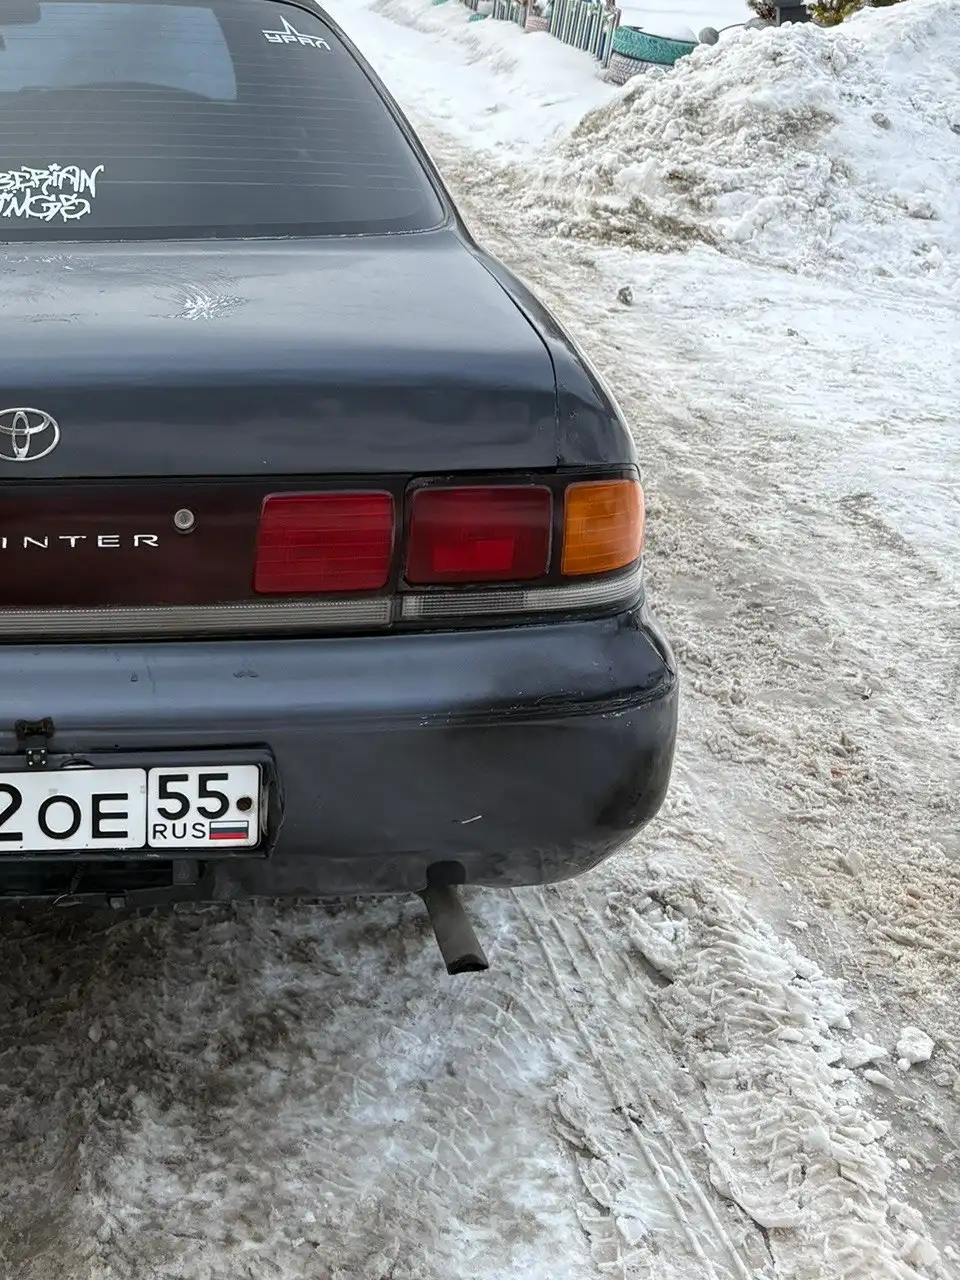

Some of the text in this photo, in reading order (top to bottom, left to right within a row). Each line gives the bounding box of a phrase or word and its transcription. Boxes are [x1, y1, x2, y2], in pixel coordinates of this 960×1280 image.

[263, 32, 332, 51] УРАЛ
[156, 772, 230, 821] 55
[152, 822, 207, 840] RUS
